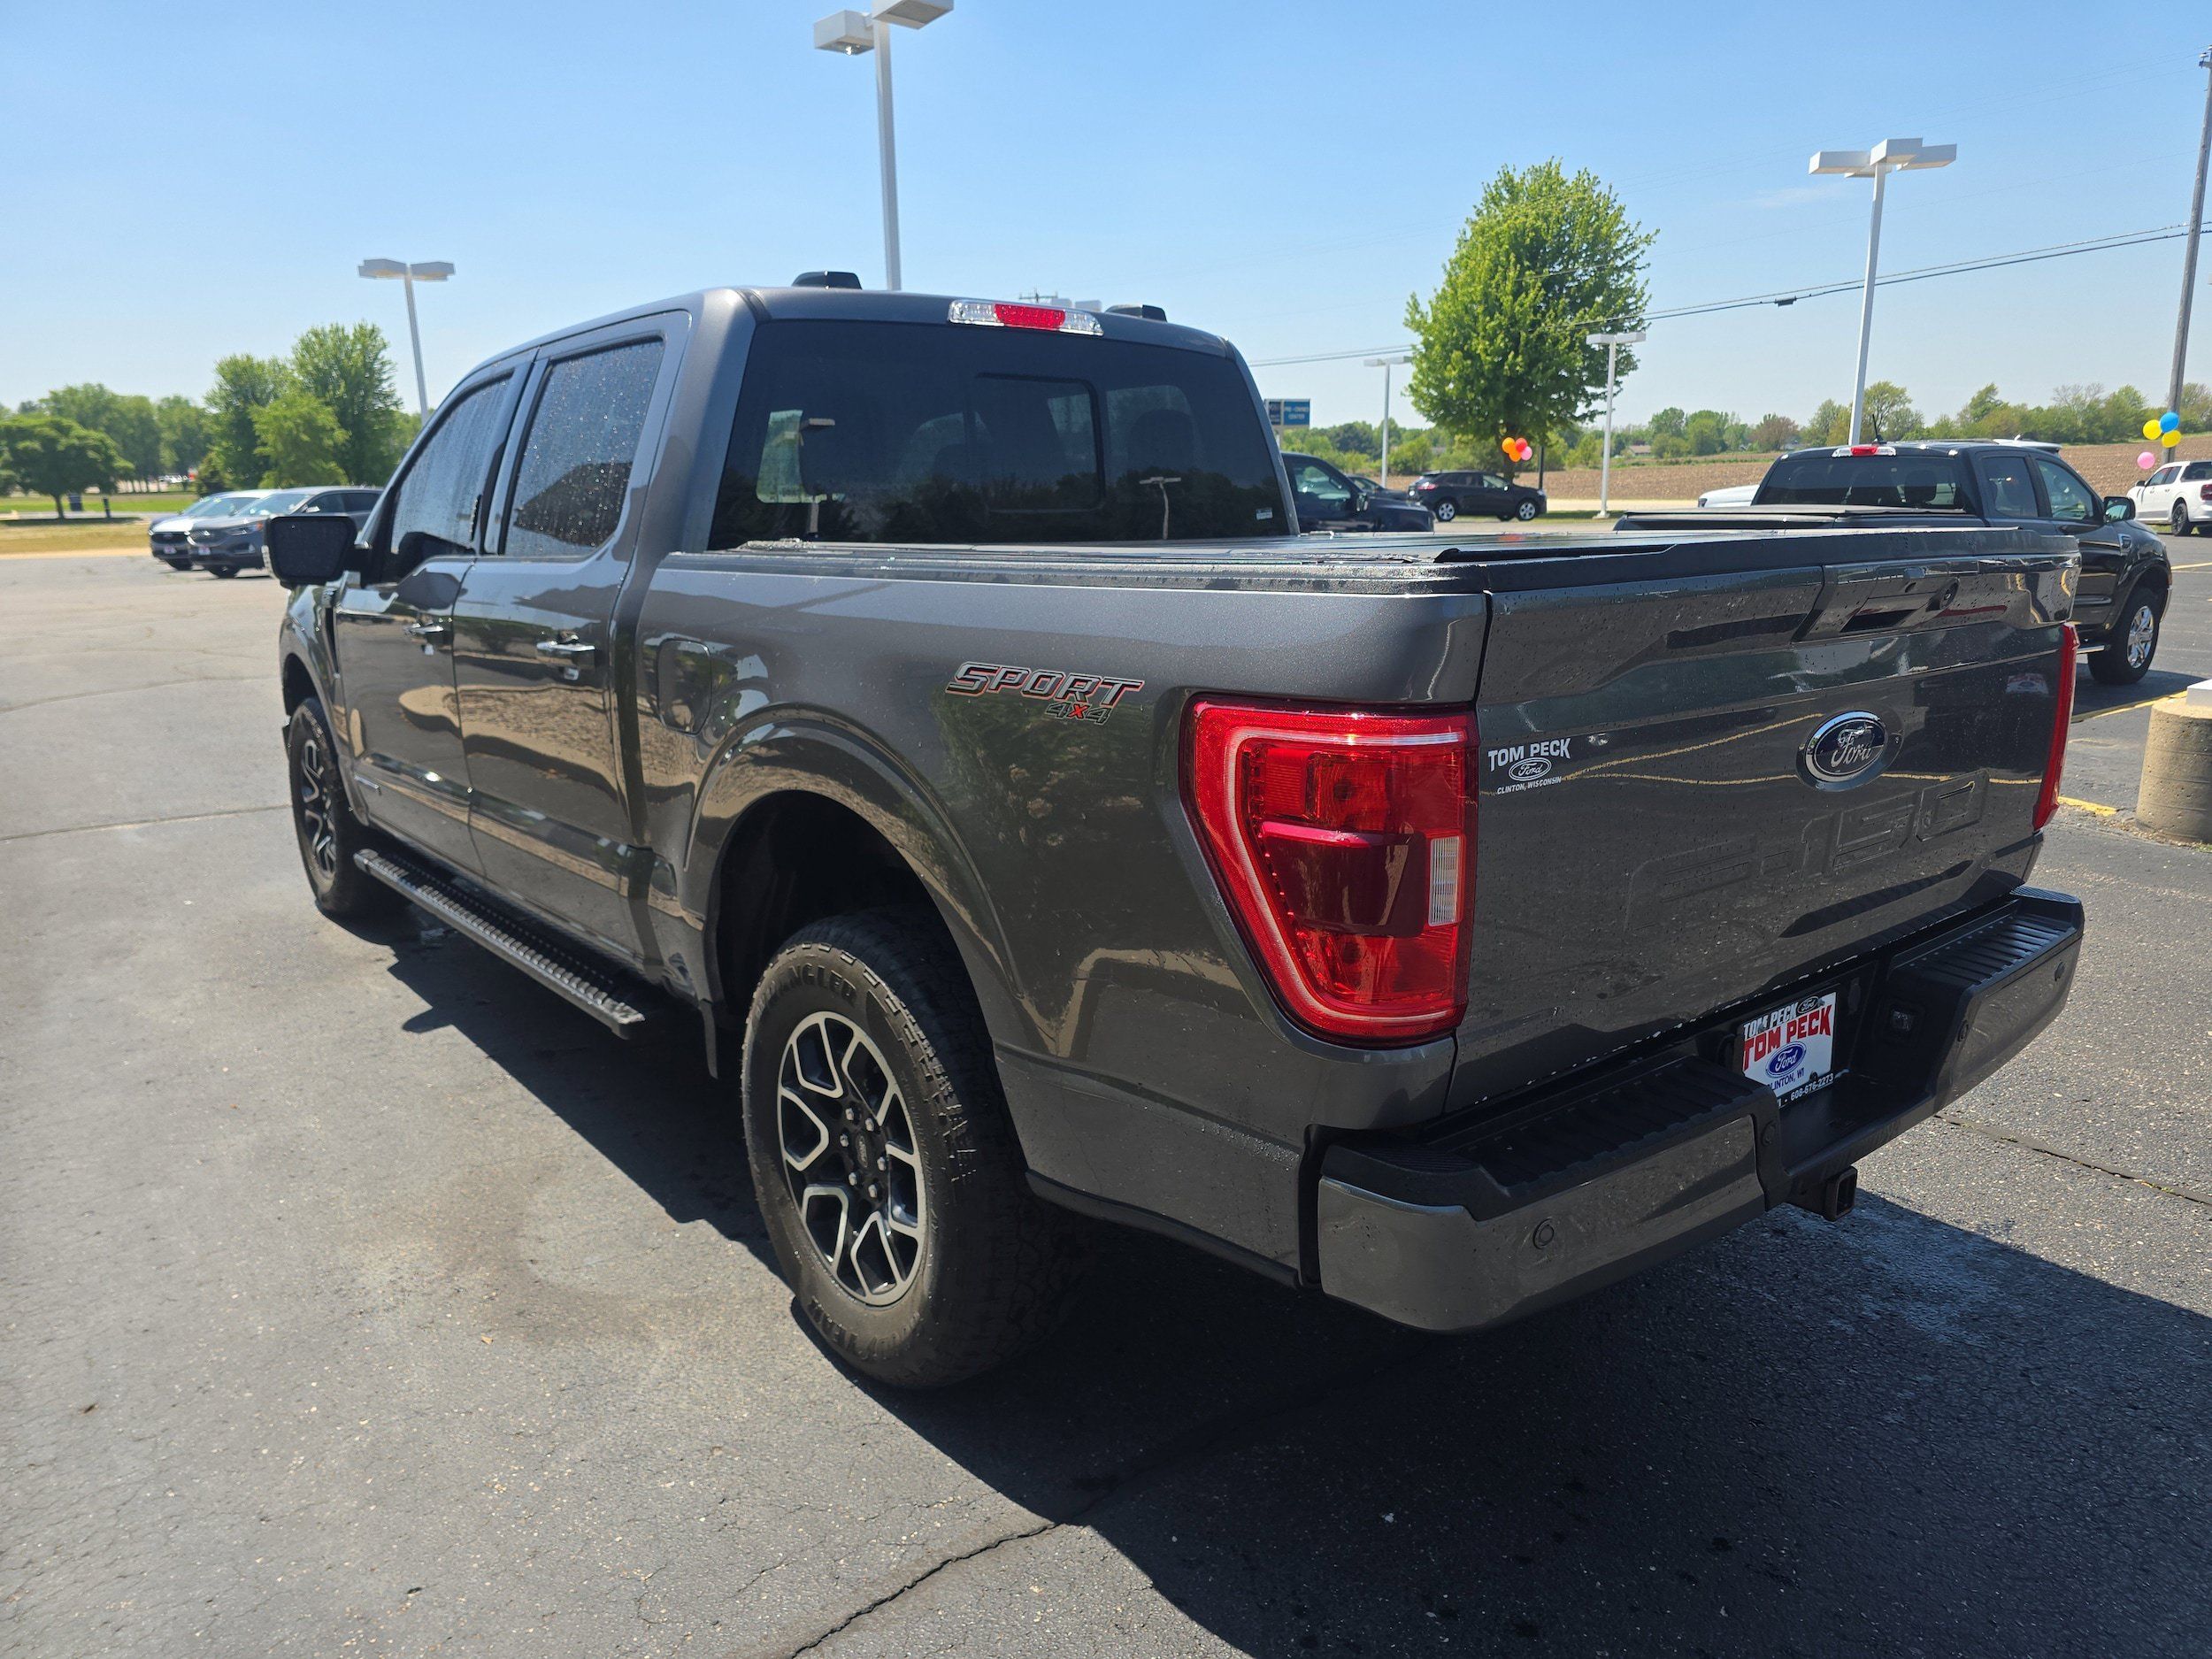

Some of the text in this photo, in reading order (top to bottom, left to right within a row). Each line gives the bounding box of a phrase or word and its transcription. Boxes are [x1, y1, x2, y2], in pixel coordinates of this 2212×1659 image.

[945, 661, 1145, 708] SPORT
[1487, 737, 1571, 772] TOM PECK
[1830, 726, 1875, 768] Ford
[1496, 776, 1562, 795] CLINTON, WISCONSIN
[1517, 762, 1543, 777] Ford
[1743, 1014, 1769, 1041] TOM
[1770, 1002, 1799, 1029] PECK
[1743, 1004, 1832, 1071] TOM PECK
[1775, 1048, 1799, 1071] Ford
[1770, 1072, 1795, 1090] LINTON,
[1790, 1072, 1834, 1102] 608-676-2273
